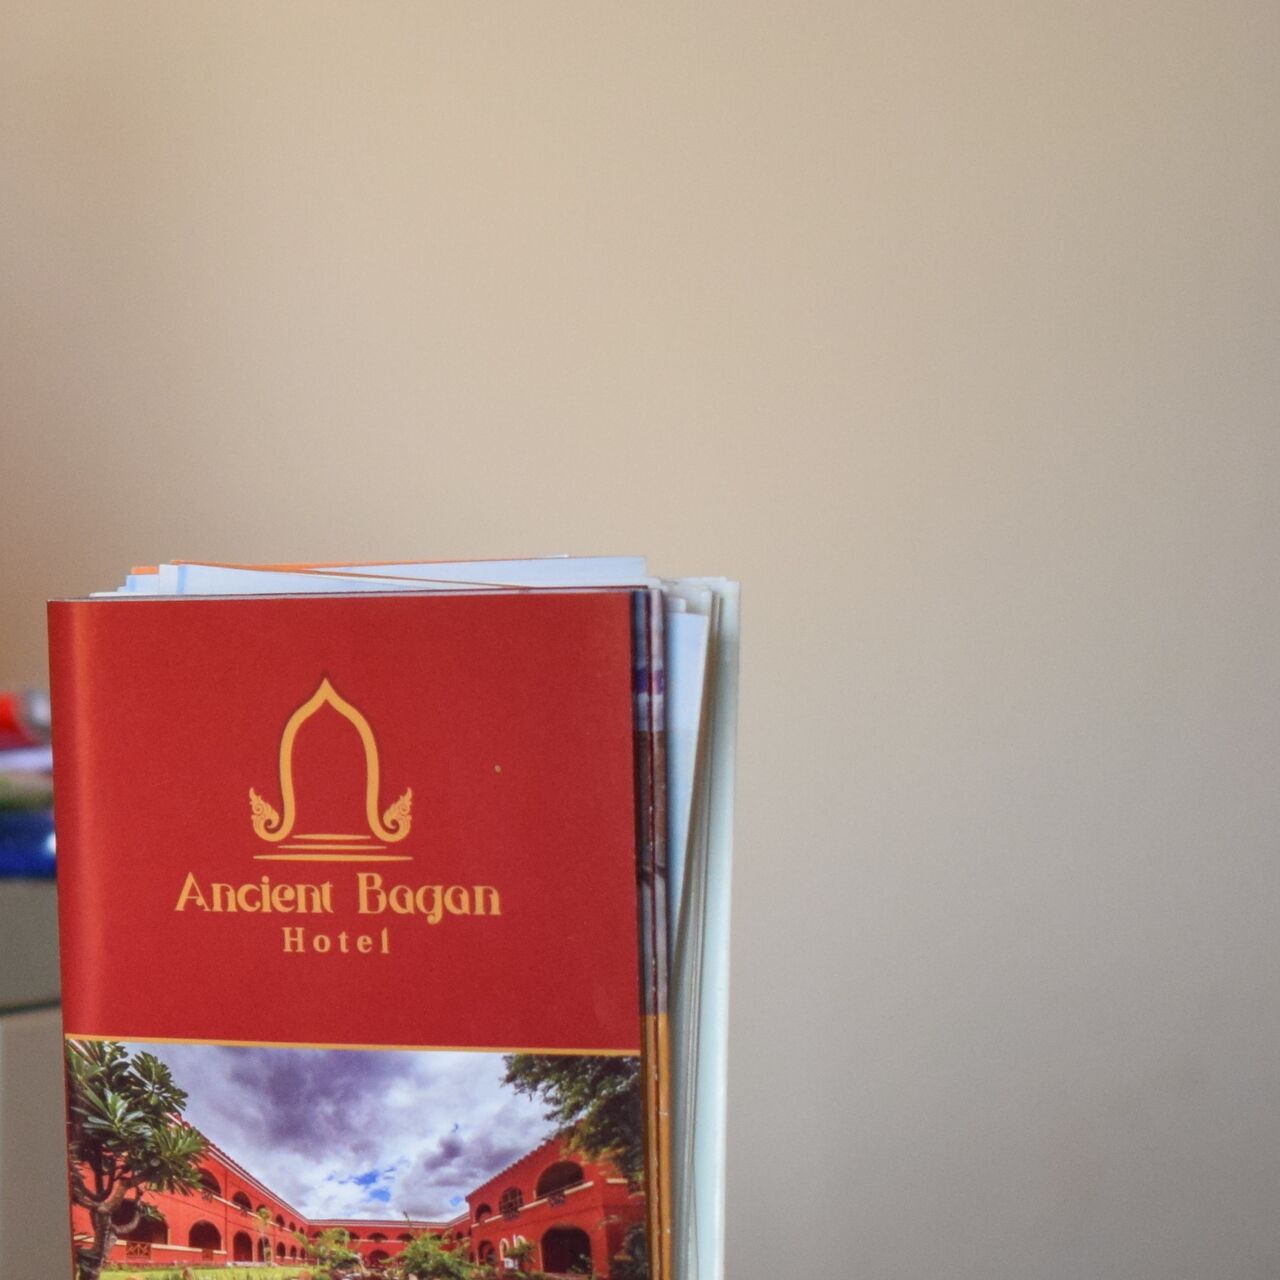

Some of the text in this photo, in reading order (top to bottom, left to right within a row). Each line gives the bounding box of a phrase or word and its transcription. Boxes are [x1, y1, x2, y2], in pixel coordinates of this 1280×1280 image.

[174, 871, 502, 925] Ancient Bagan
[282, 926, 390, 954] Hotel
